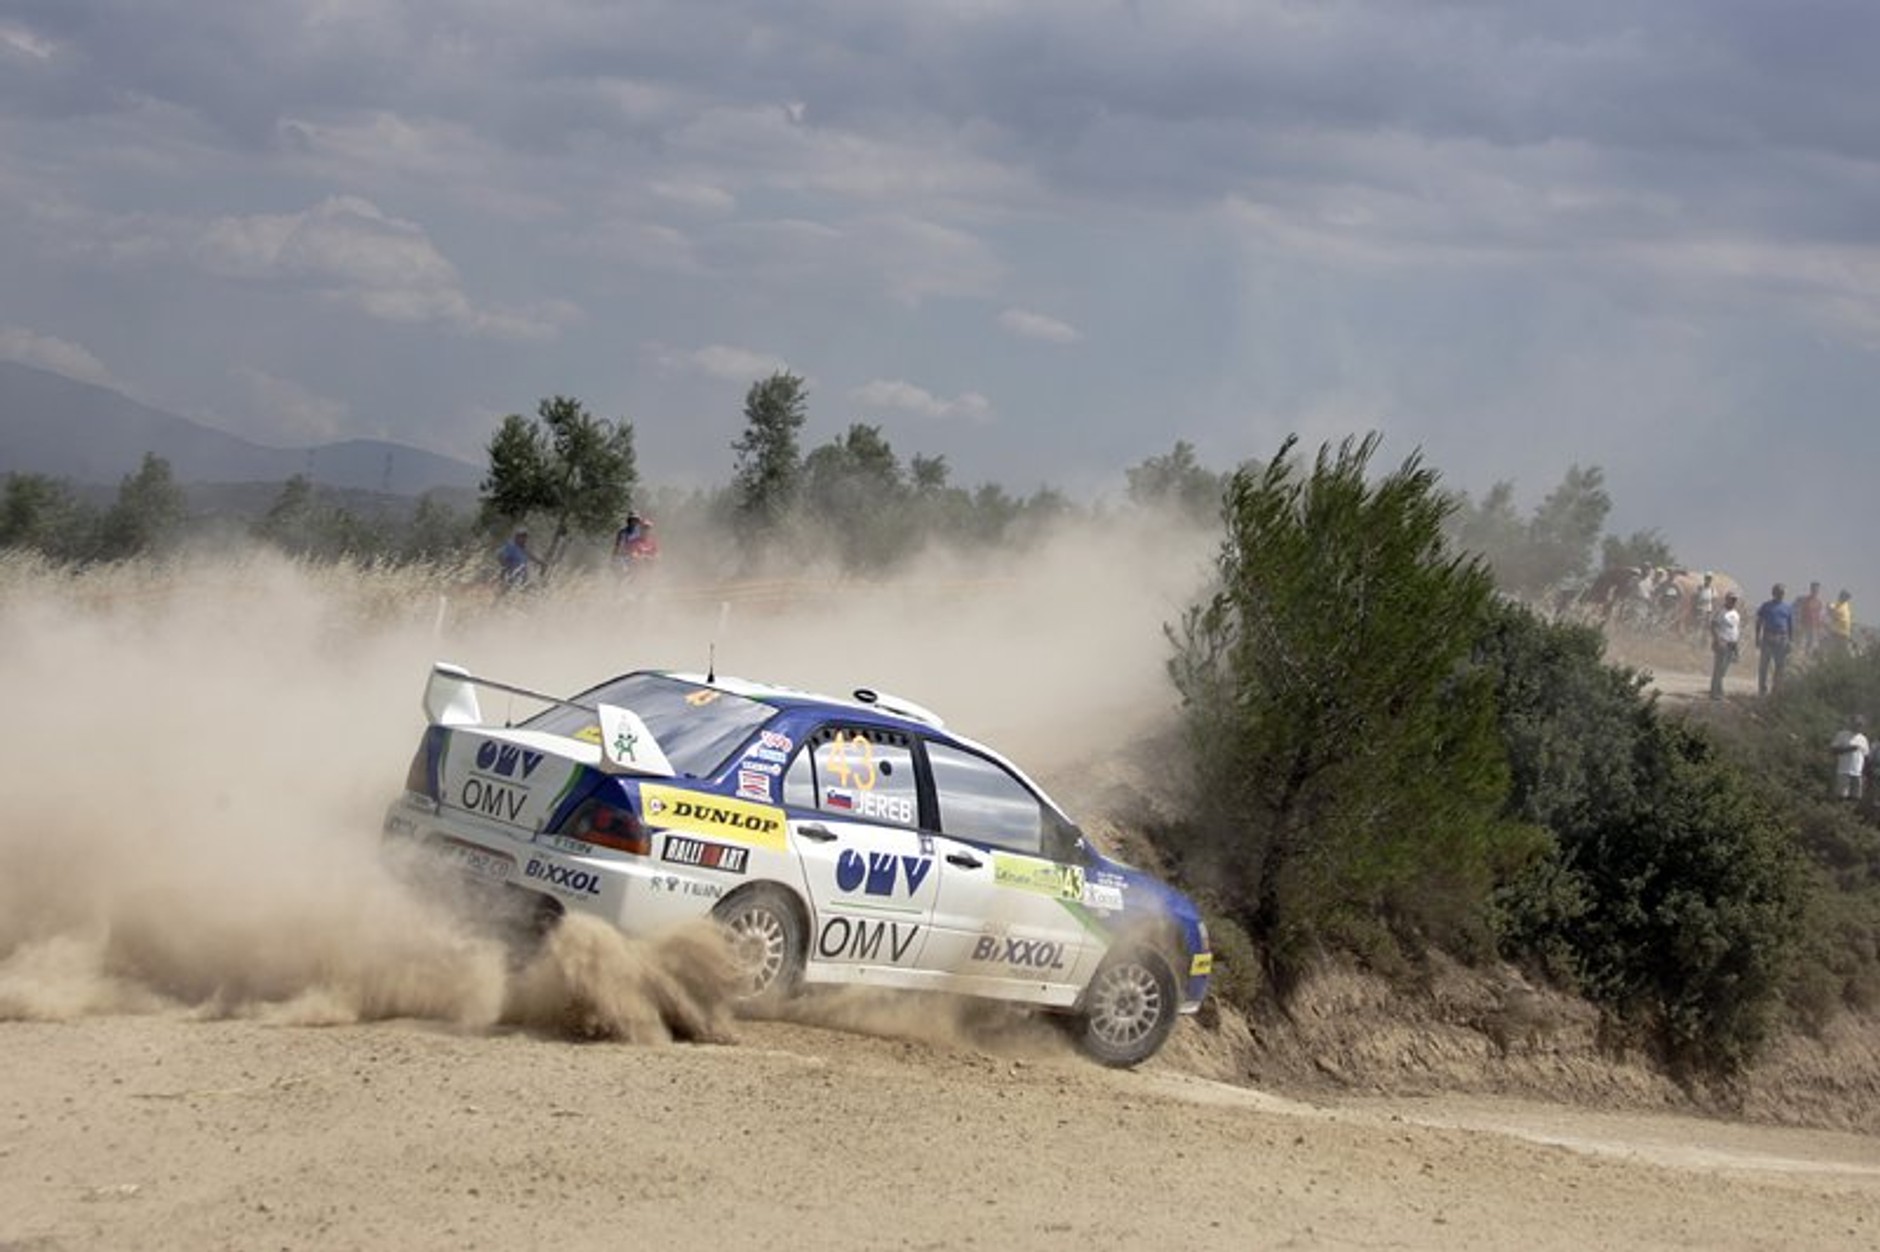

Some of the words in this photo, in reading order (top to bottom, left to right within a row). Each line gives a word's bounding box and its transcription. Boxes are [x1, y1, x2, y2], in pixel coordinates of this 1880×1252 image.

[476, 740, 544, 779] OMV
[827, 730, 876, 791] 43
[462, 779, 527, 820] OMV
[673, 802, 778, 833] DUNLOP
[856, 790, 911, 822] JEREB
[836, 847, 932, 897] OMV
[819, 916, 920, 962] OMV
